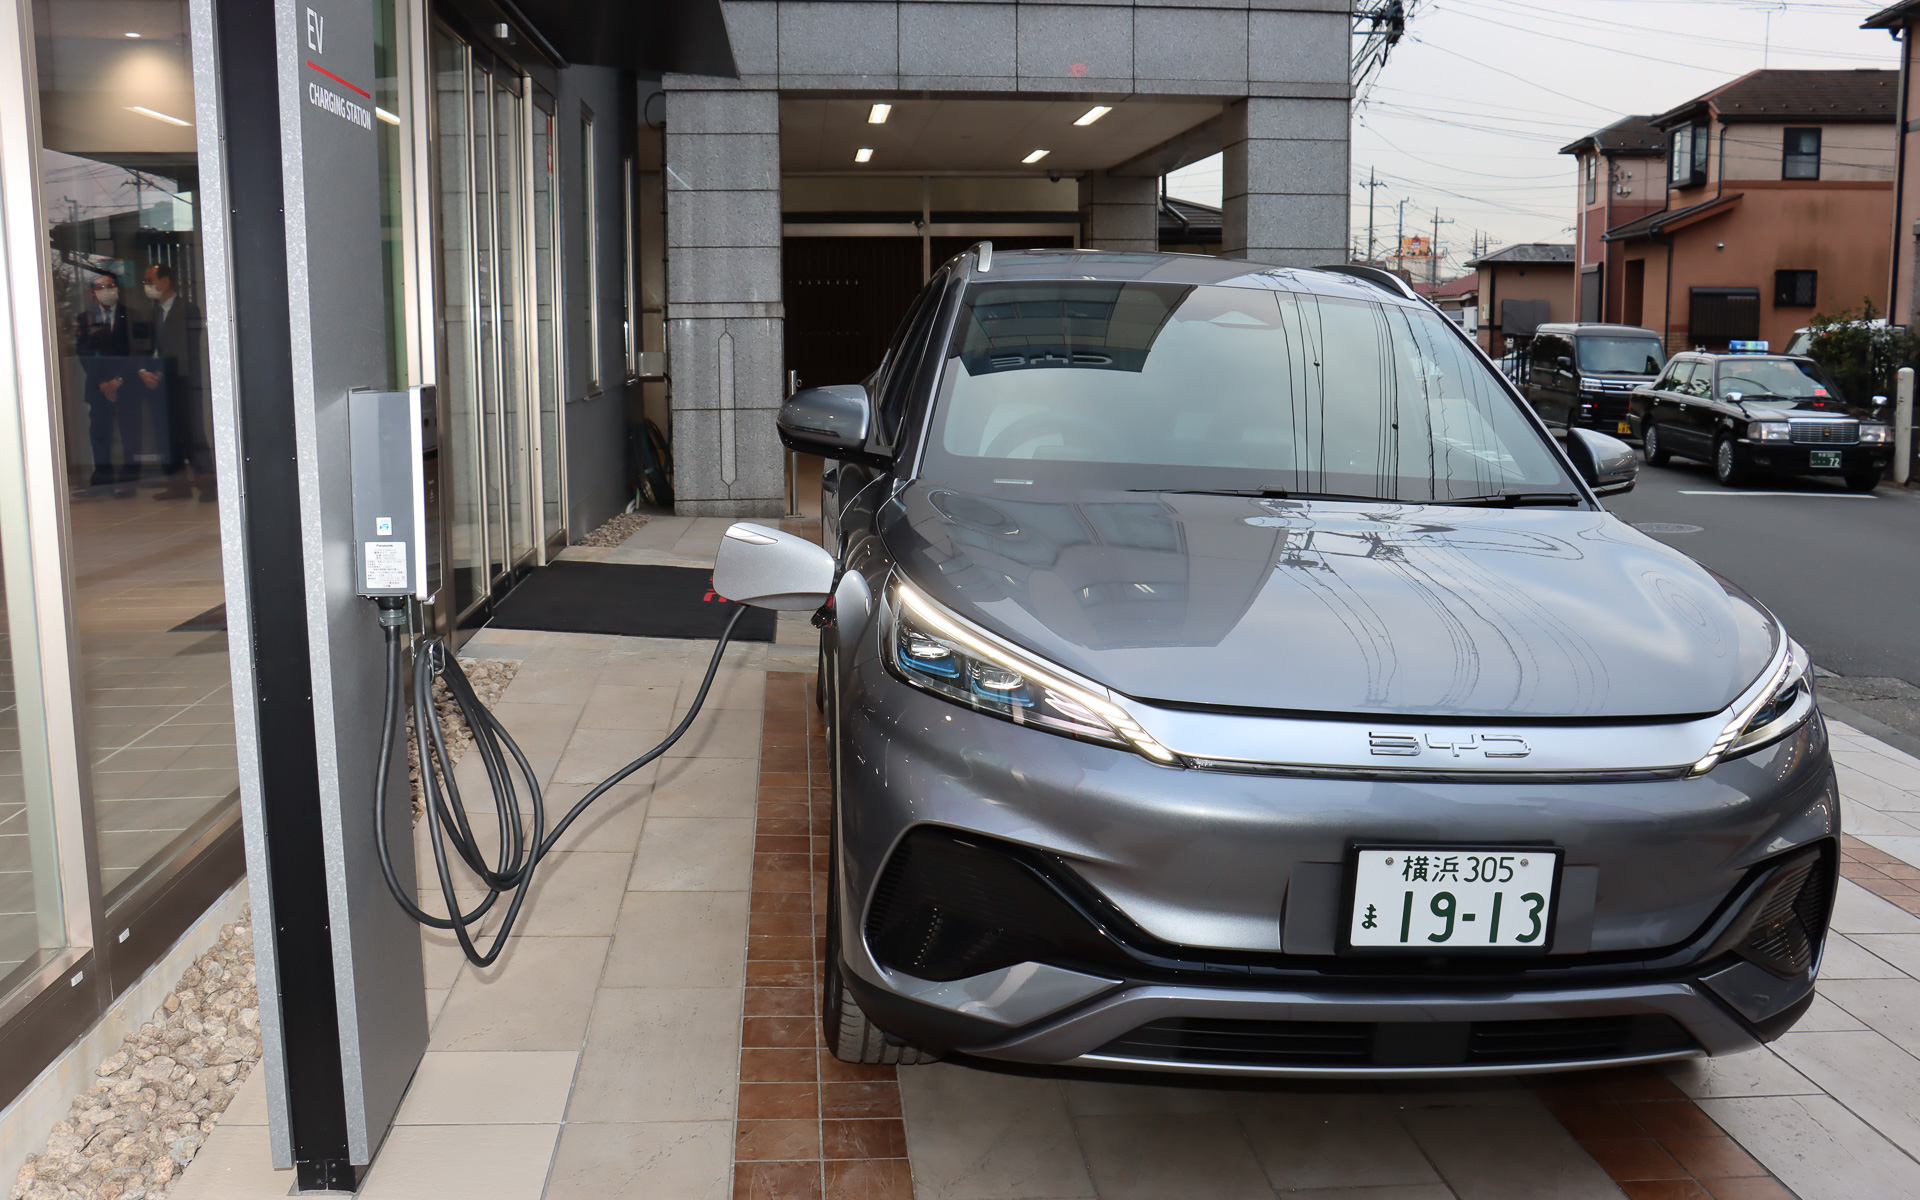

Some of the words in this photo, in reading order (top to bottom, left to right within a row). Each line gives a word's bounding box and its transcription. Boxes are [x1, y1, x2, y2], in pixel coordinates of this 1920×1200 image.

[306, 6, 324, 55] EV
[309, 82, 346, 119] CHARGING
[345, 100, 372, 131] STATION
[1829, 457, 1840, 467] 72
[1368, 731, 1532, 758] BYD
[1361, 904, 1378, 929] ま
[1400, 891, 1545, 943] 19-13
